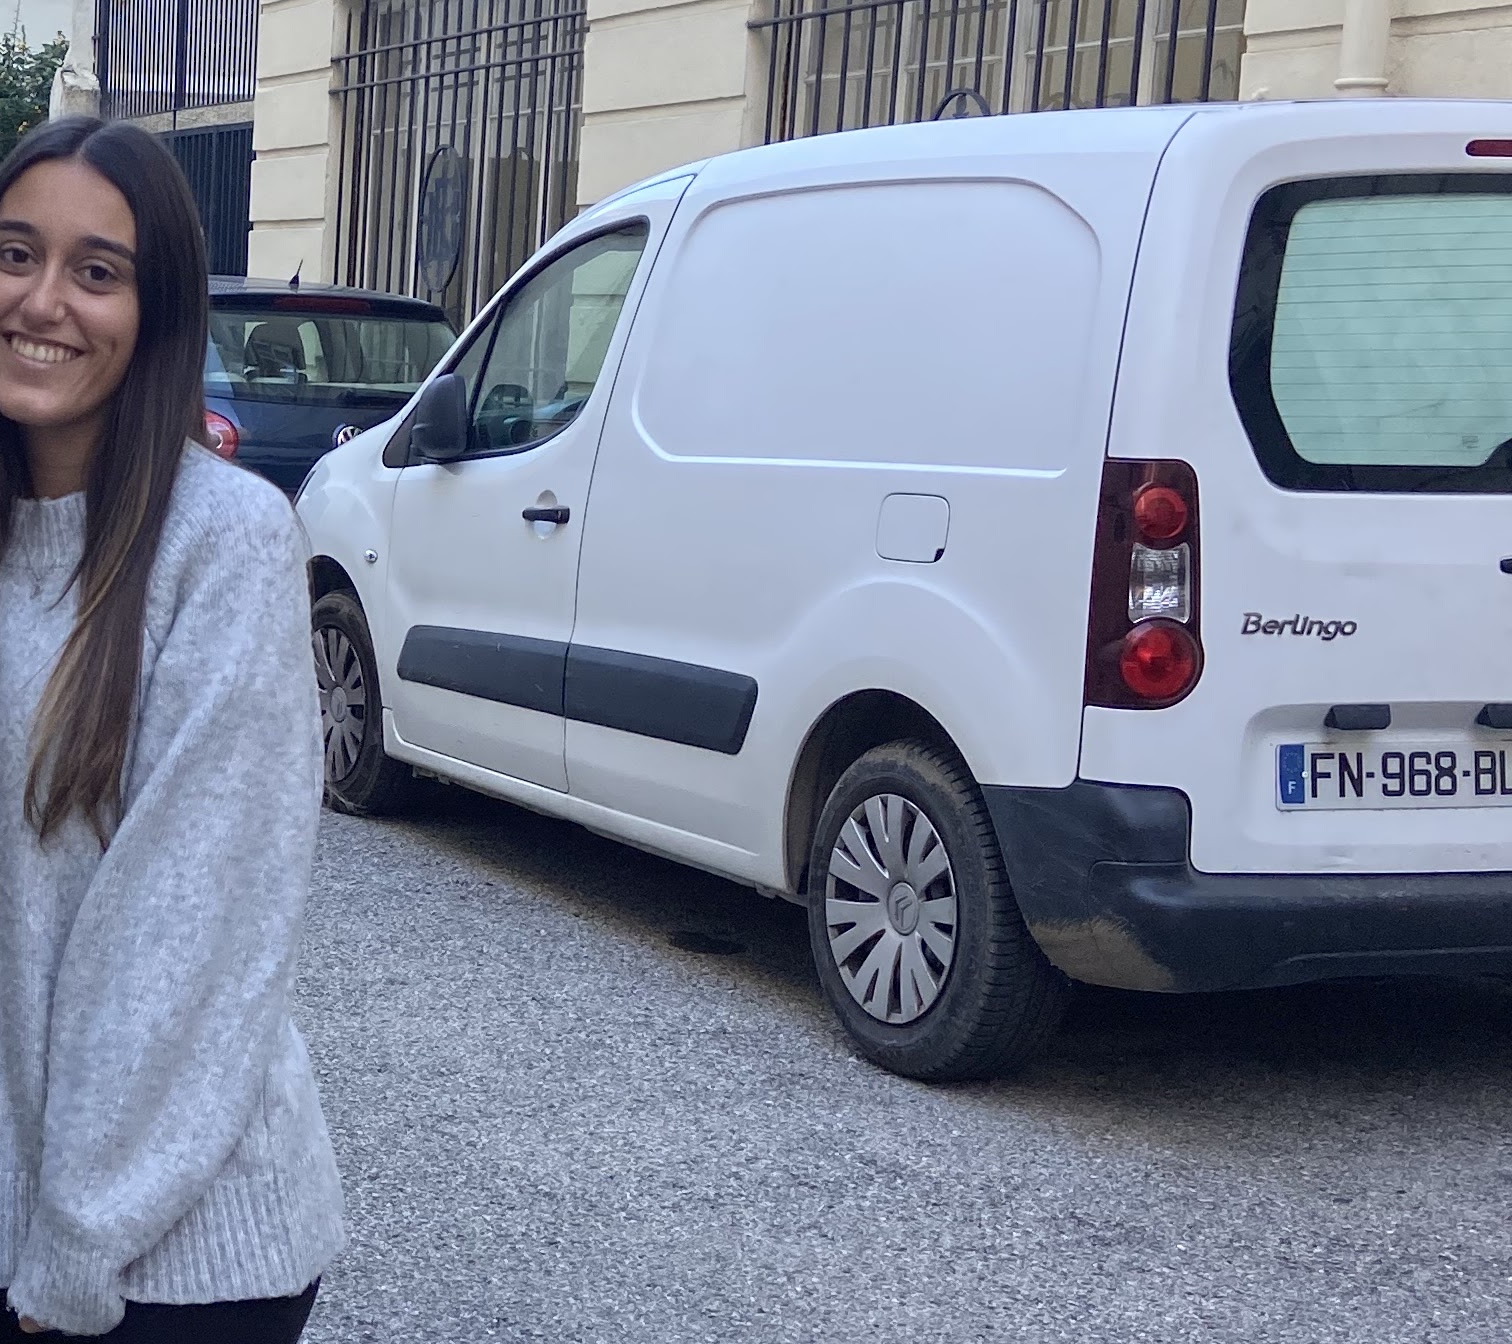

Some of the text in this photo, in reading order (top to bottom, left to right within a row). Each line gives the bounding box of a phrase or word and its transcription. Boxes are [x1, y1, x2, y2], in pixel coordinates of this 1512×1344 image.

[1240, 611, 1358, 641] Berlingo
[1287, 780, 1297, 795] F
[1310, 750, 1512, 798] FN-968-BL
